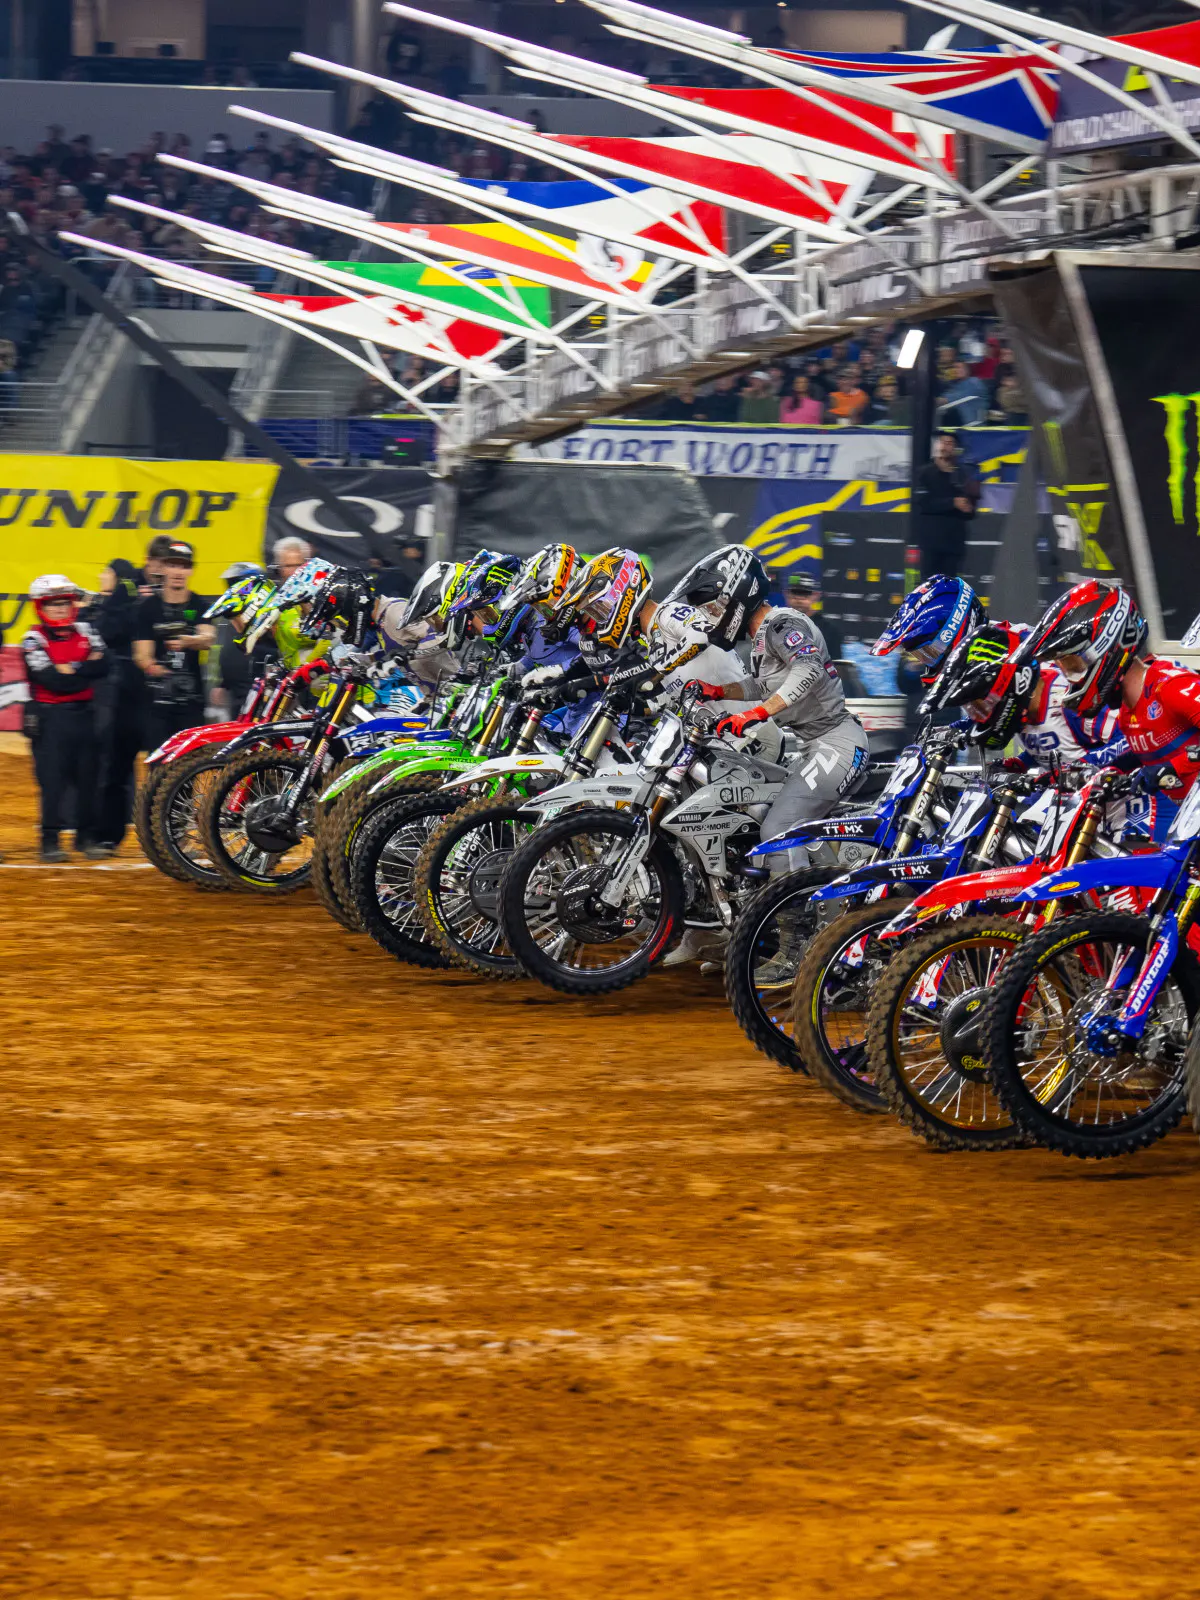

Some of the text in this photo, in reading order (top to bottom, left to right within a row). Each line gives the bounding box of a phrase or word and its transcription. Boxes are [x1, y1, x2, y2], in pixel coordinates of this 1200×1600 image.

[563, 436, 840, 477] FORT WORTH
[0, 487, 238, 530] UNLOP
[611, 587, 636, 639] ROCKSTAR
[1094, 592, 1132, 653] SCOTT
[786, 667, 821, 704] CLUBMX
[677, 813, 703, 823] YAMAHA
[980, 866, 1028, 879] PROGRESSIVE
[981, 929, 1023, 943] DUNL
[1130, 940, 1170, 1014] DUNLOP
